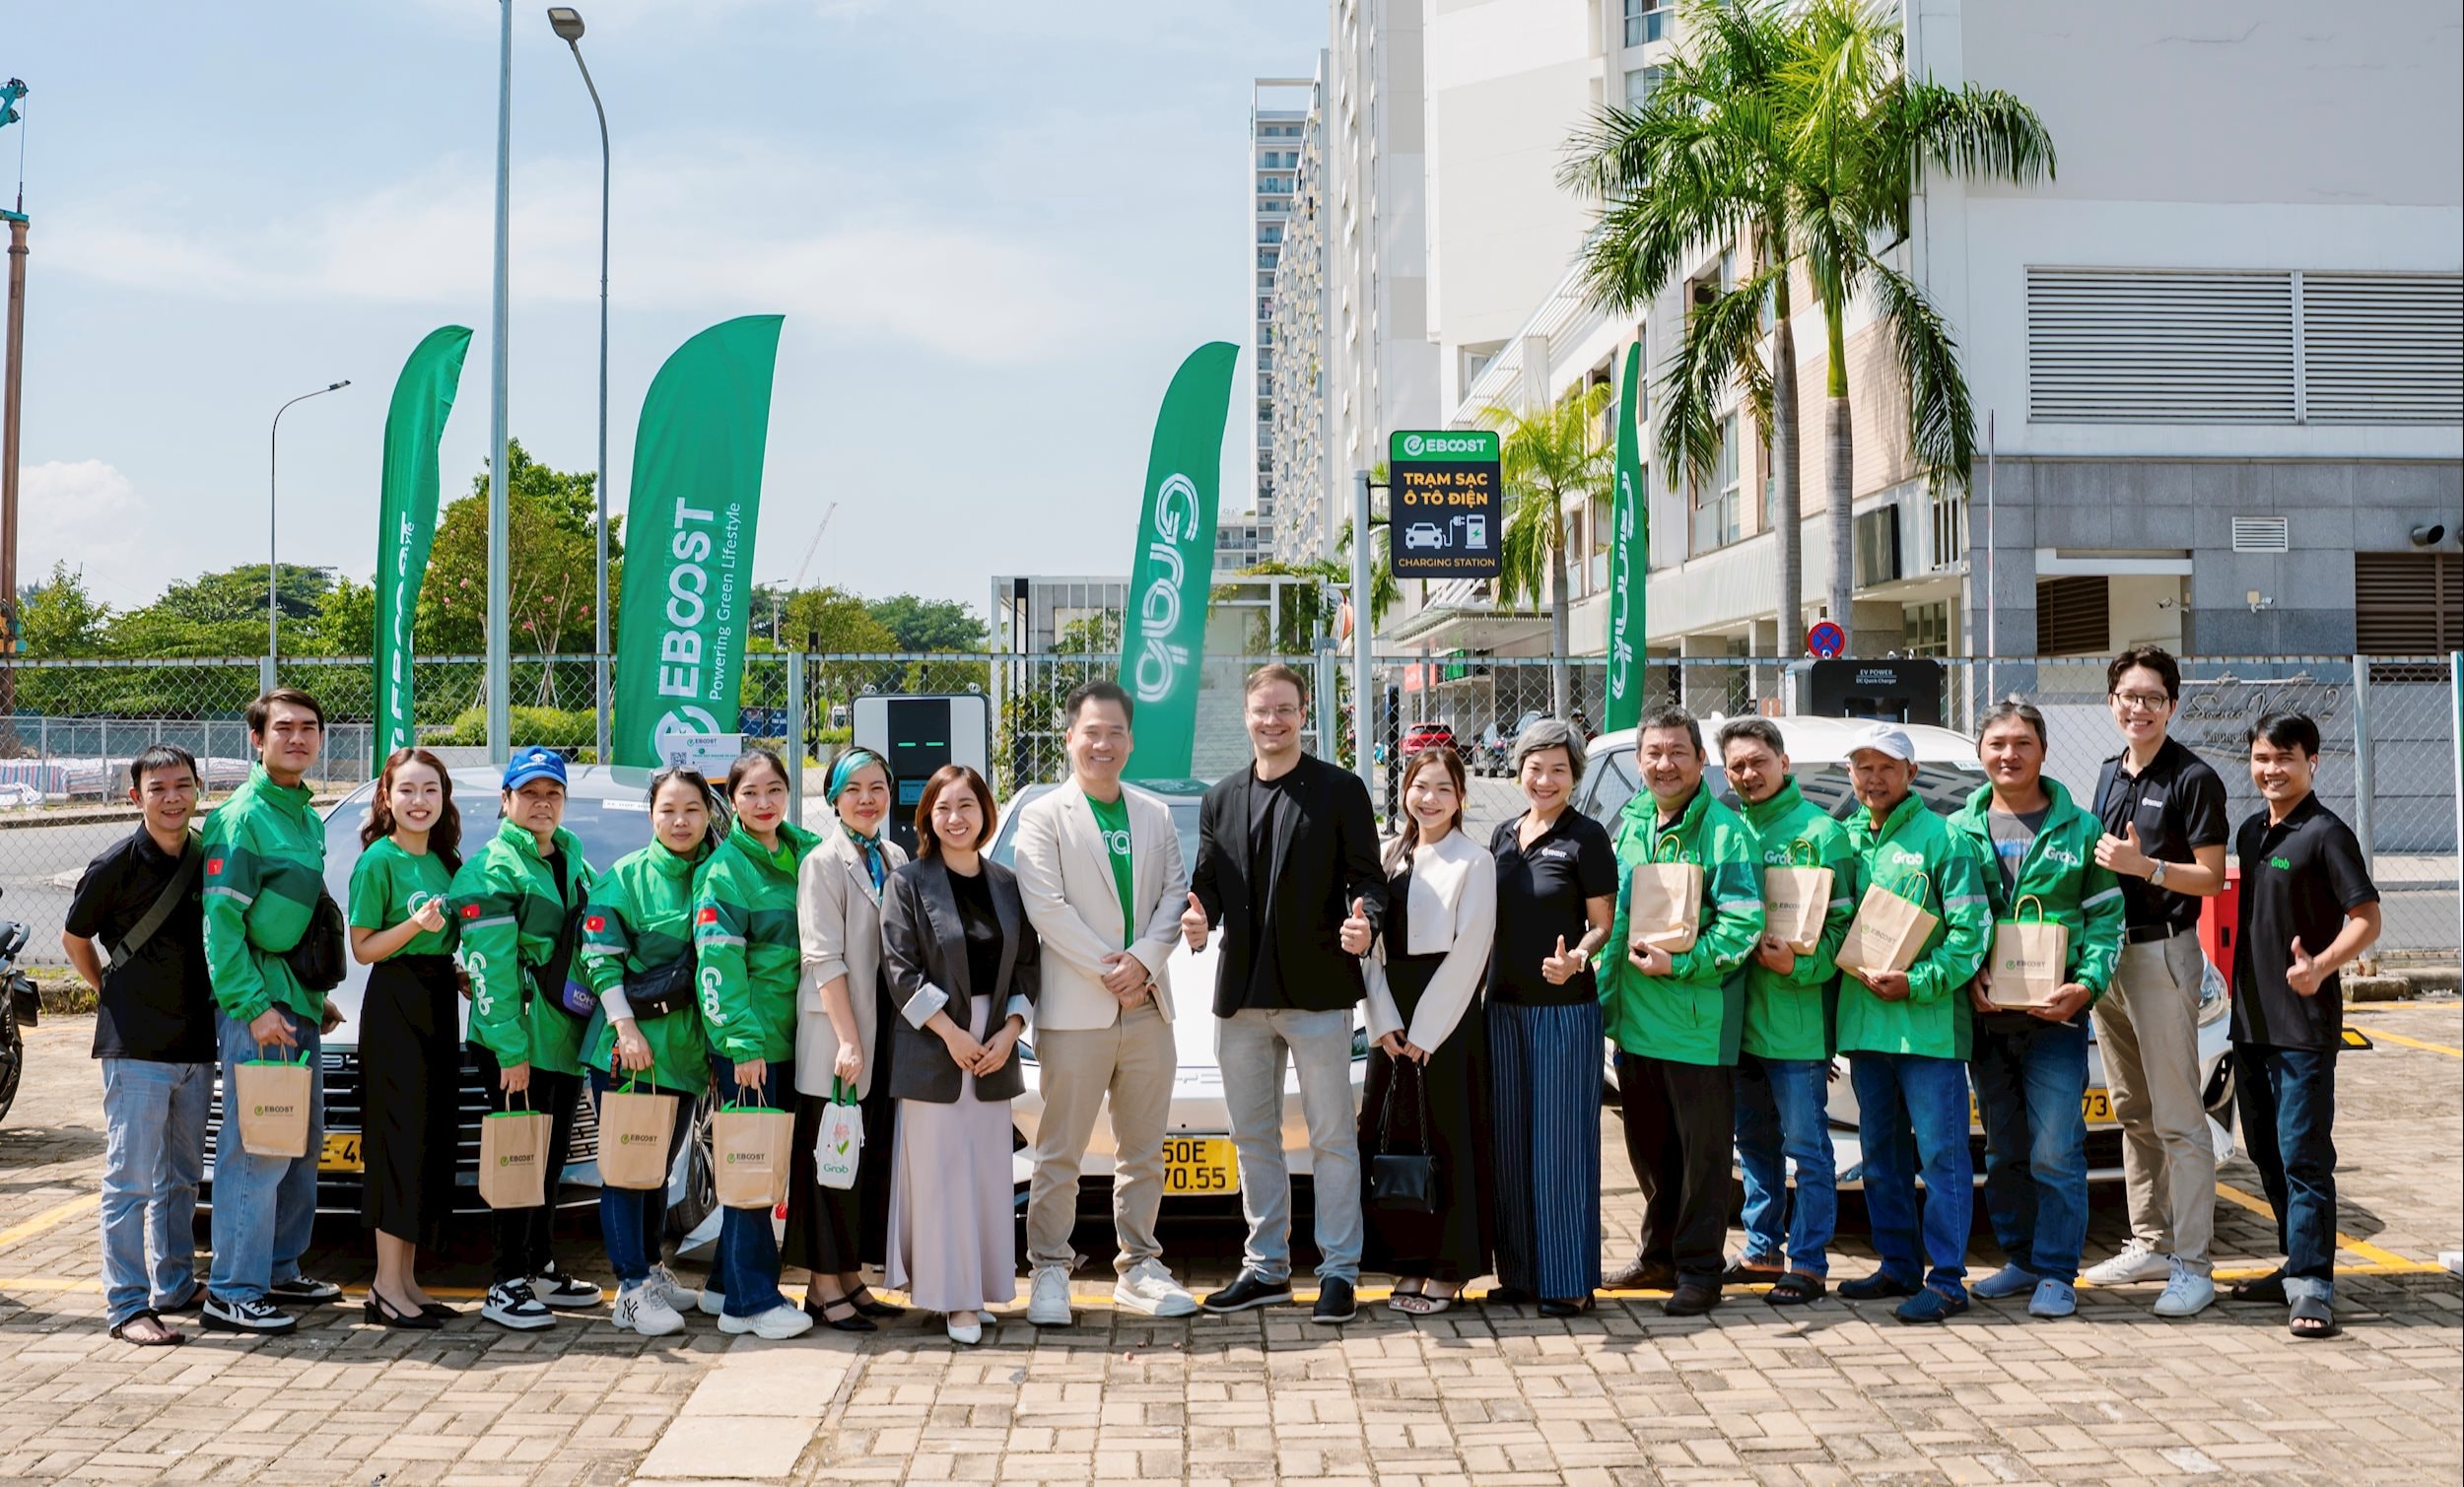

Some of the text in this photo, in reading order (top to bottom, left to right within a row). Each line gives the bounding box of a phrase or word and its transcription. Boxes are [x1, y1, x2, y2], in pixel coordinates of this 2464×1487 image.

[1426, 439, 1486, 452] EBOOST
[1403, 473, 1488, 489] TRẠM SẠC
[1403, 490, 1488, 508] Ô TÔ ĐIỆN
[1399, 558, 1495, 568] CHARGING STATION
[1135, 473, 1200, 703] Grab
[658, 497, 715, 699] EBOOST
[710, 503, 741, 701] Powering Green Lifestyle
[2319, 688, 2341, 720] 2
[1891, 850, 1925, 866] Grab
[2044, 845, 2078, 866] Grab
[2271, 855, 2290, 870] Grab
[468, 951, 495, 1016] Grab
[823, 1163, 849, 1174] Grab
[1164, 1167, 1226, 1189] 70.55
